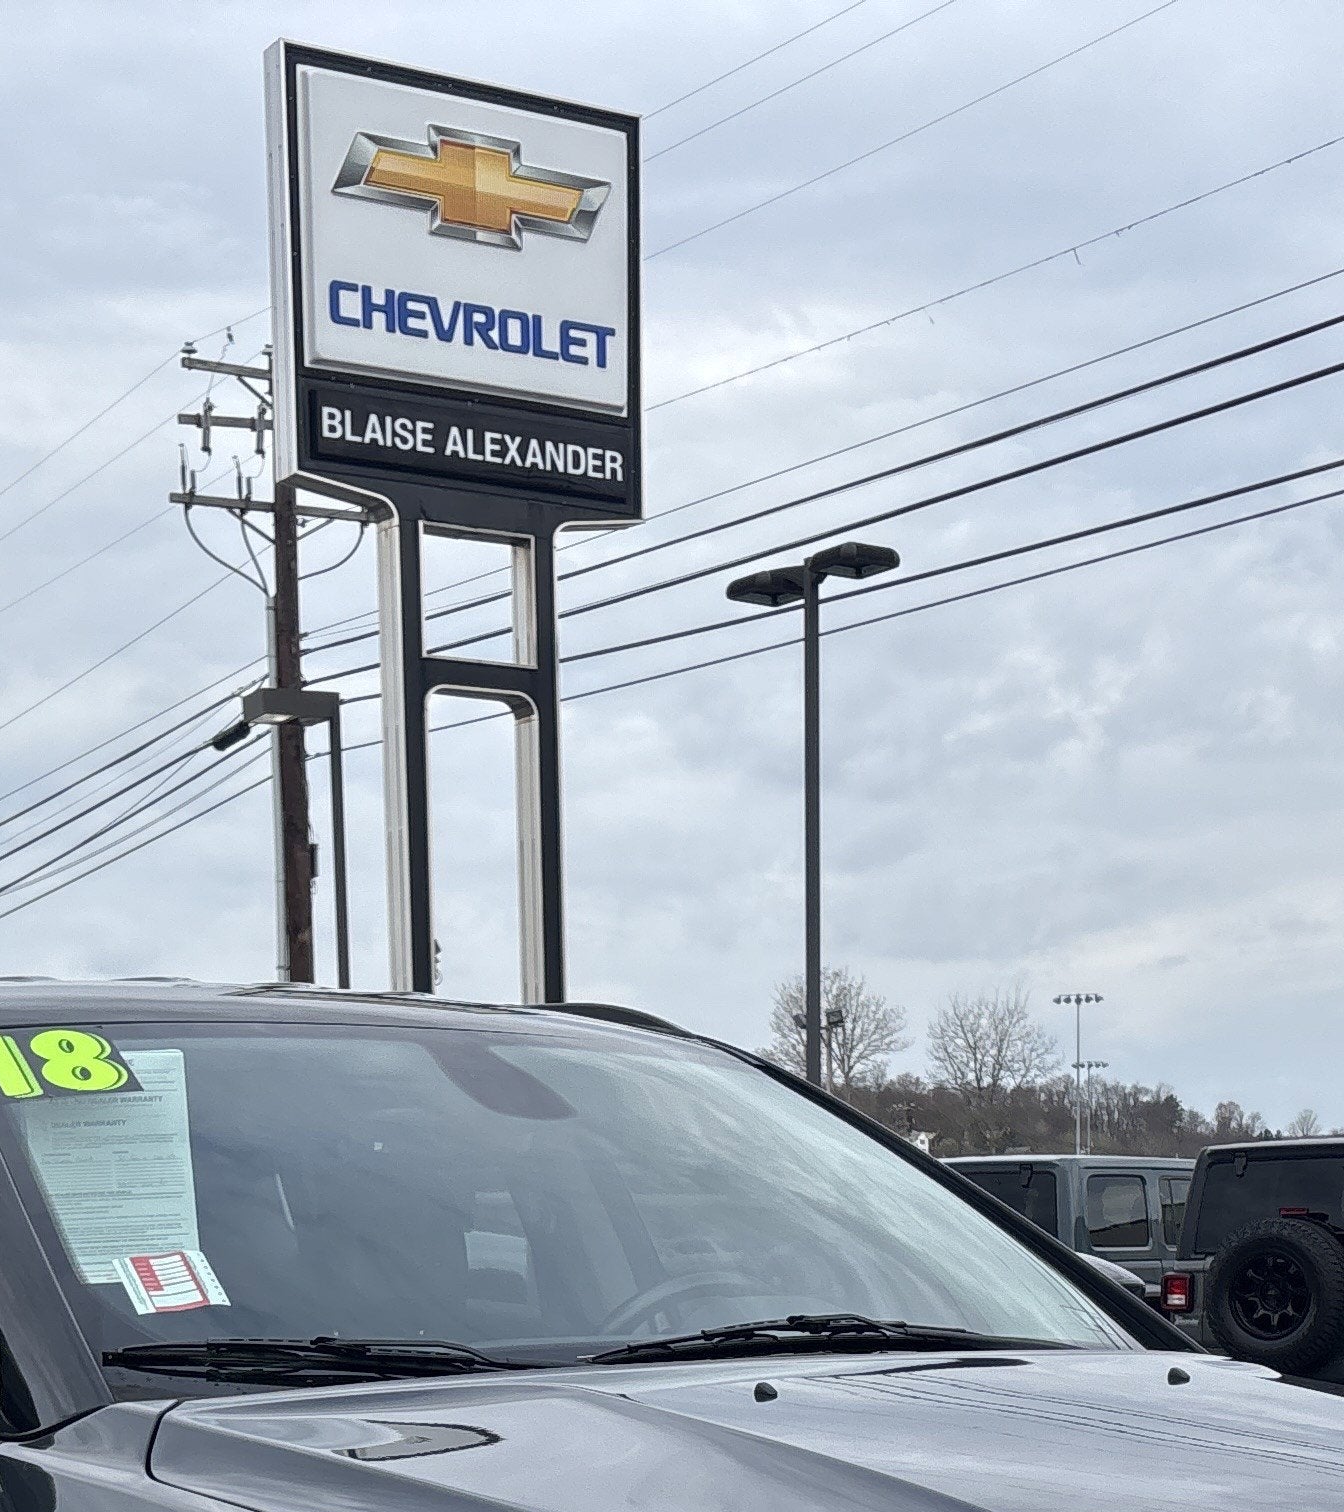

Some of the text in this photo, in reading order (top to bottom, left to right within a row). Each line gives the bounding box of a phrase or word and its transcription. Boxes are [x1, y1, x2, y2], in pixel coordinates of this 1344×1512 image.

[328, 280, 616, 369] CHEVROLET
[320, 405, 625, 483] BLAISE ALEXANDER
